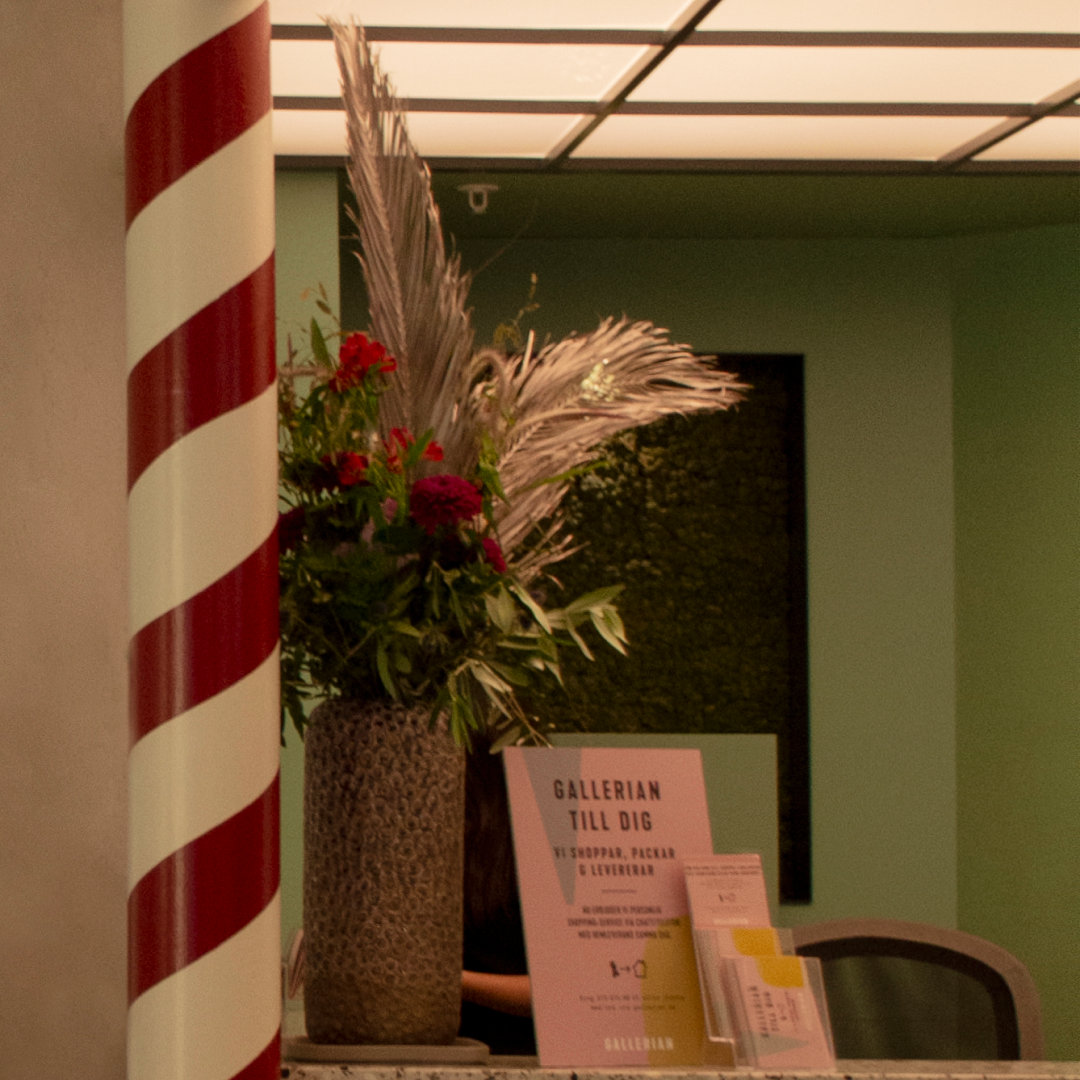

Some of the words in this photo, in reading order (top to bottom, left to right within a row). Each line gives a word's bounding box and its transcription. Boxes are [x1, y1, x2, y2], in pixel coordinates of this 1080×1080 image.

[553, 778, 661, 801] GALLERIAN
[568, 809, 610, 831] TILL
[619, 810, 653, 832] DIG
[553, 846, 566, 860] VI
[570, 846, 628, 861] SHOPPAR,
[631, 846, 675, 860] PACKAR
[590, 863, 655, 877] LEVERERAR
[603, 1037, 674, 1052] GALLERIAN
